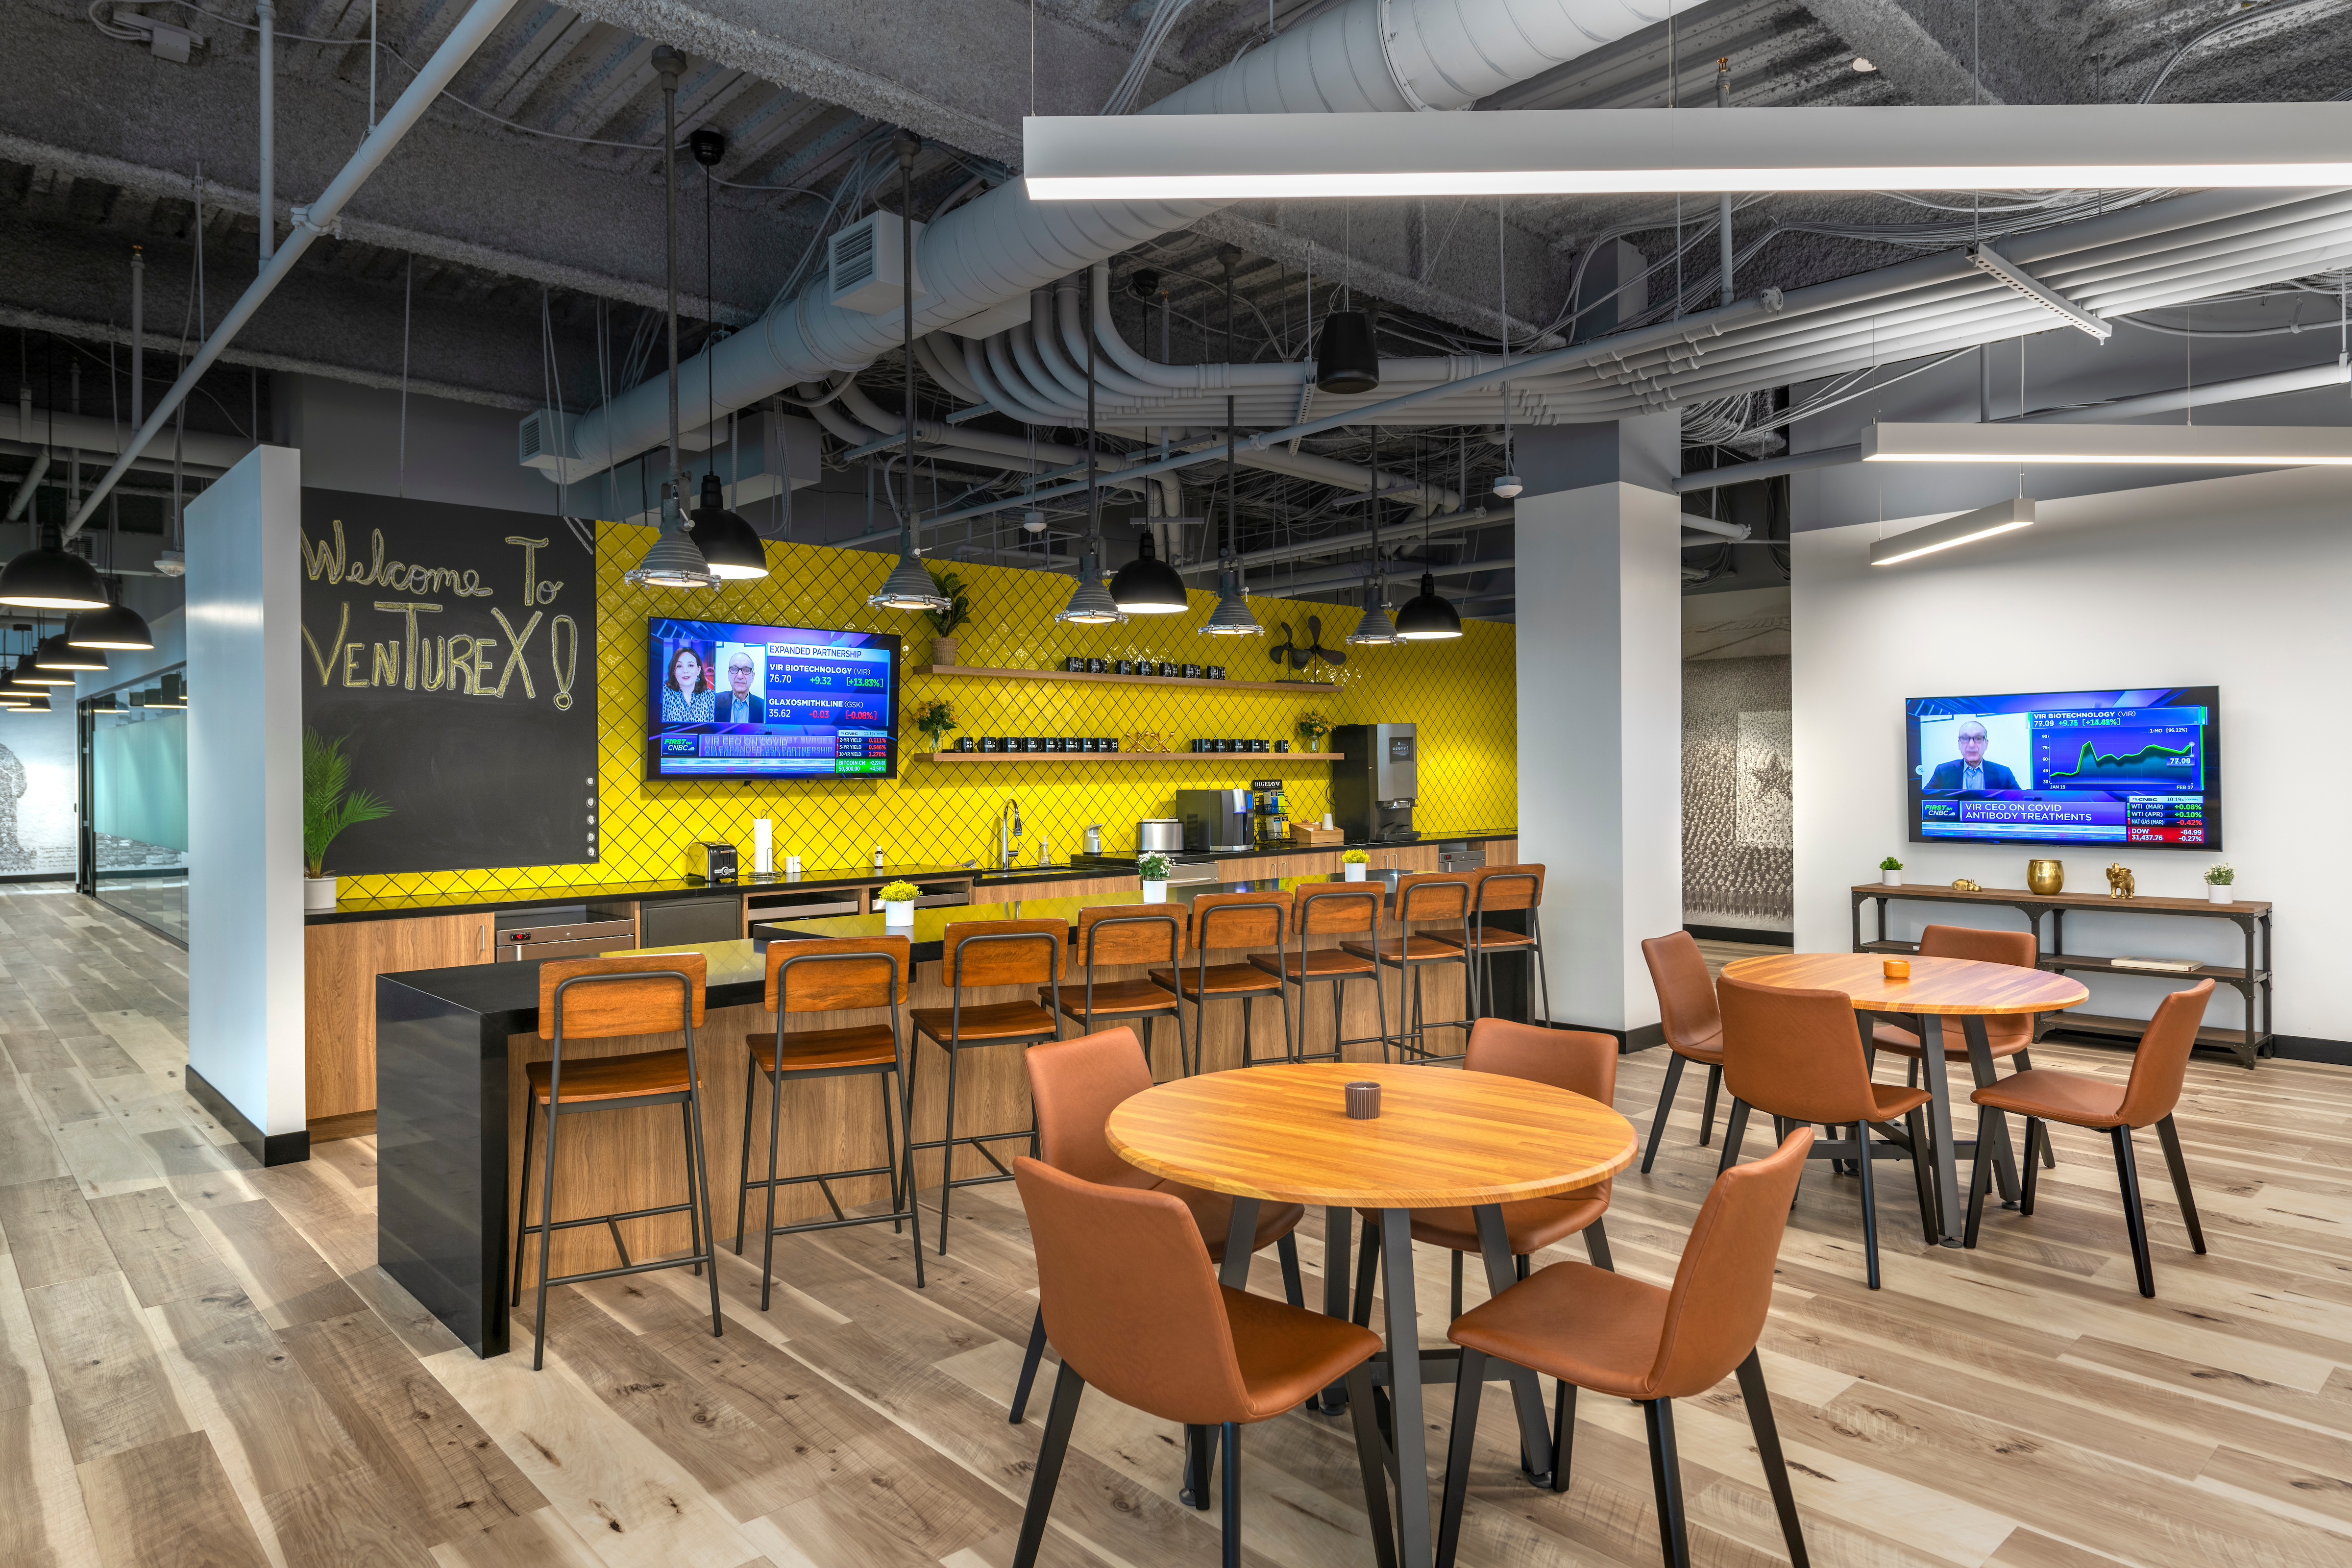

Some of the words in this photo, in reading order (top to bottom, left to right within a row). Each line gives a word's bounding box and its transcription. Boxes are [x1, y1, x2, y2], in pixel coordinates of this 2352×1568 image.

[301, 519, 493, 597] Welcome
[505, 536, 564, 606] To
[770, 645, 810, 655] EXPANDED
[812, 648, 861, 658] PARTNERSHIP
[785, 664, 852, 674] BIOTECHNOLOGY
[769, 674, 792, 683] 76.70
[810, 676, 832, 685] +9.32
[847, 677, 883, 687] [+13.83%]
[769, 698, 843, 707] GLAXOSMITHKLINE
[768, 709, 791, 718] 35.62
[809, 710, 829, 718] -0.03
[846, 710, 877, 720] [-0.08%]
[704, 737, 719, 746] VIR
[723, 737, 741, 746] CEO
[744, 737, 757, 746] ON
[760, 738, 787, 746] COVID
[1965, 811, 2017, 820] ANTIBODY
[2021, 812, 2092, 821] TREATMENTS
